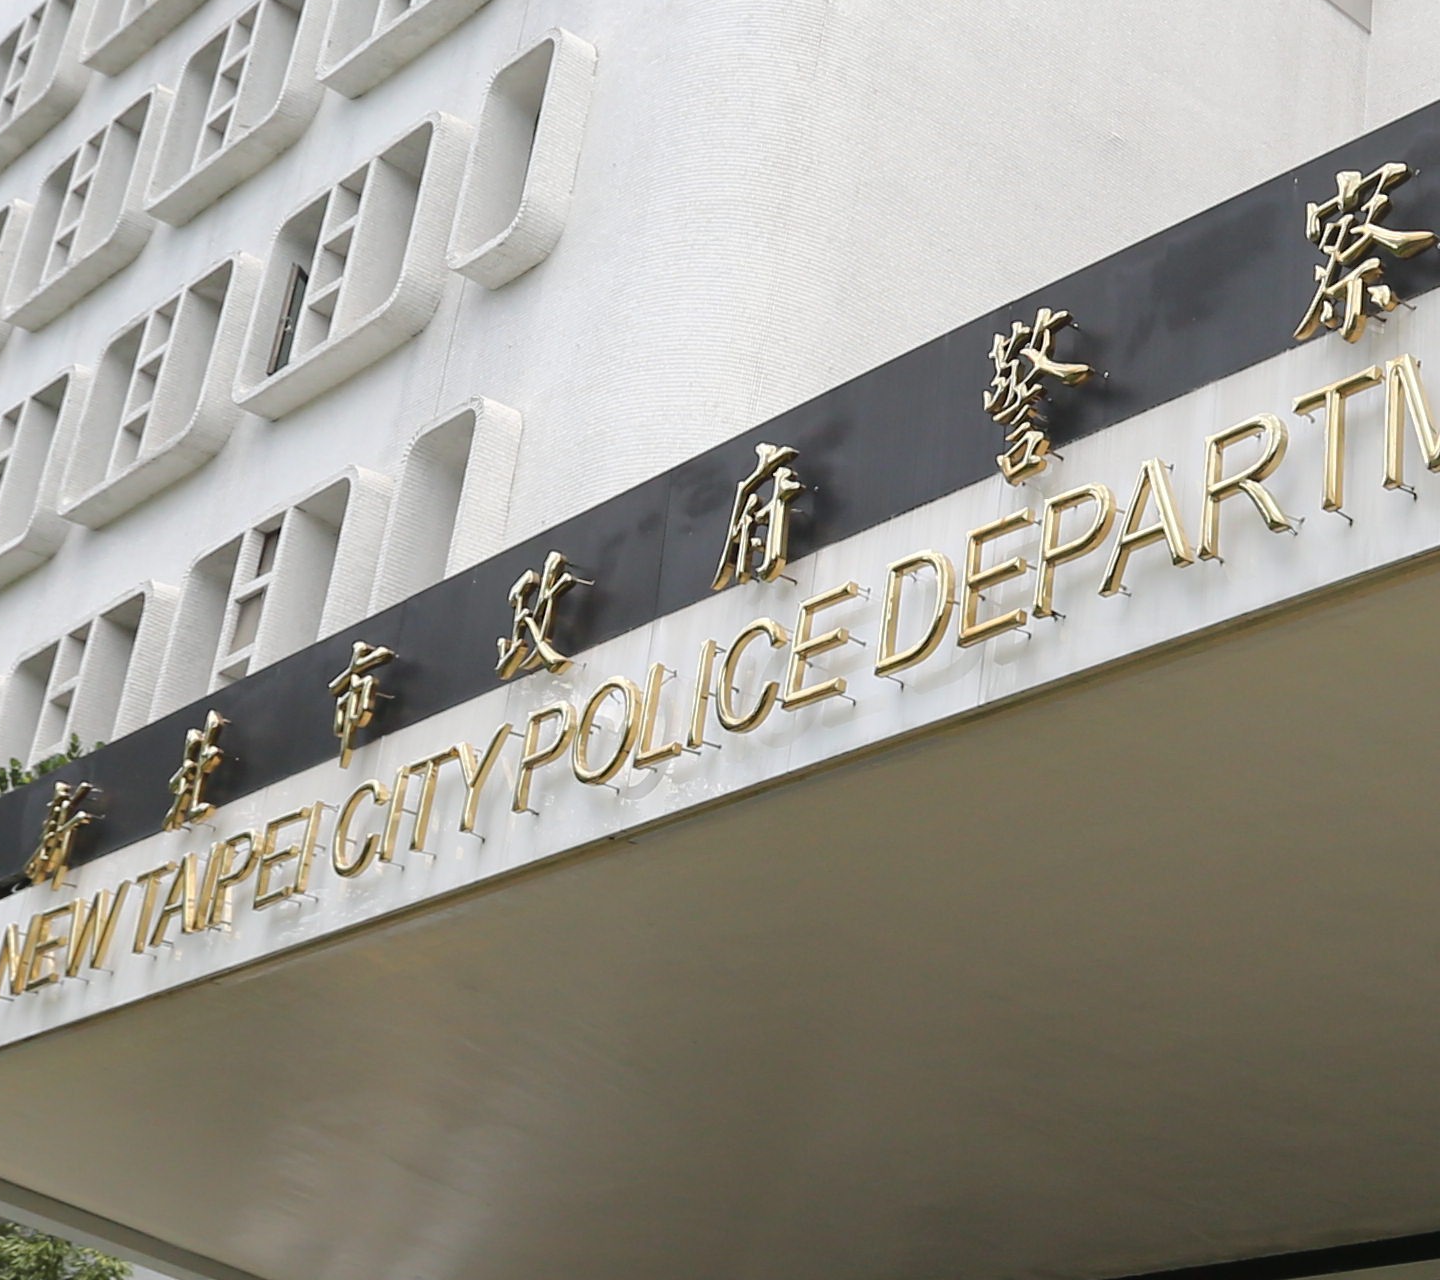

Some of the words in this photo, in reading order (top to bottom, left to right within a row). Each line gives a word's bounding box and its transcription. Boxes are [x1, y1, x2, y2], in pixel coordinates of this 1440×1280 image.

[133, 801, 323, 954] TAIPEI
[332, 723, 513, 878] CITY
[511, 582, 859, 814] POLICE
